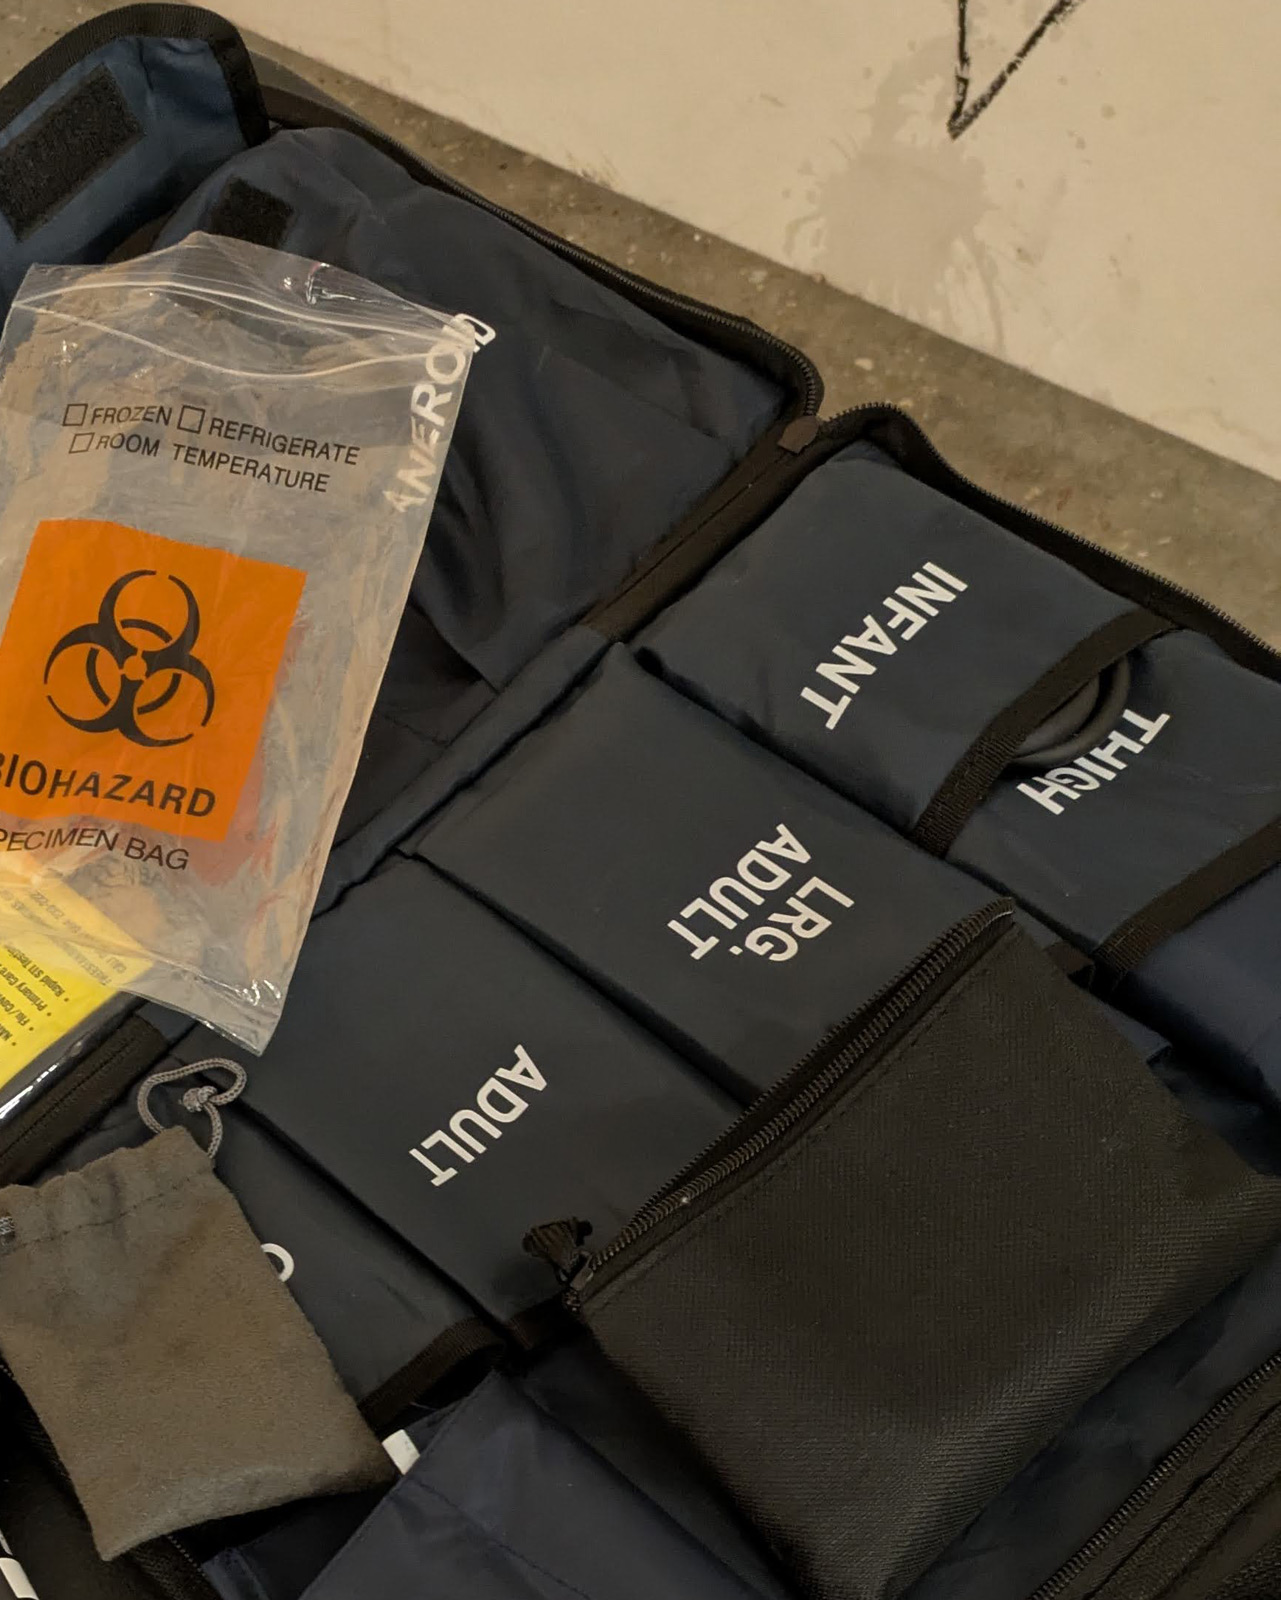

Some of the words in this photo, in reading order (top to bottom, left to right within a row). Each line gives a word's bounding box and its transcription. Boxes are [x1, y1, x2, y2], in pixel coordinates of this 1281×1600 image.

[91, 405, 172, 426] FROZEN
[208, 417, 361, 465] REFRIGERATE
[382, 313, 496, 512] ANEROID
[95, 433, 159, 457] ROOM
[173, 443, 329, 492] TEMPERATURE
[800, 562, 968, 731] INFANT
[1016, 708, 1171, 815] THIGH
[124, 838, 189, 870] BAG
[667, 823, 812, 961] ADULT
[729, 876, 854, 963] LRG.
[15, 982, 48, 1012] Primary
[41, 975, 65, 997] Rapid
[409, 1045, 549, 1187] ADULT
